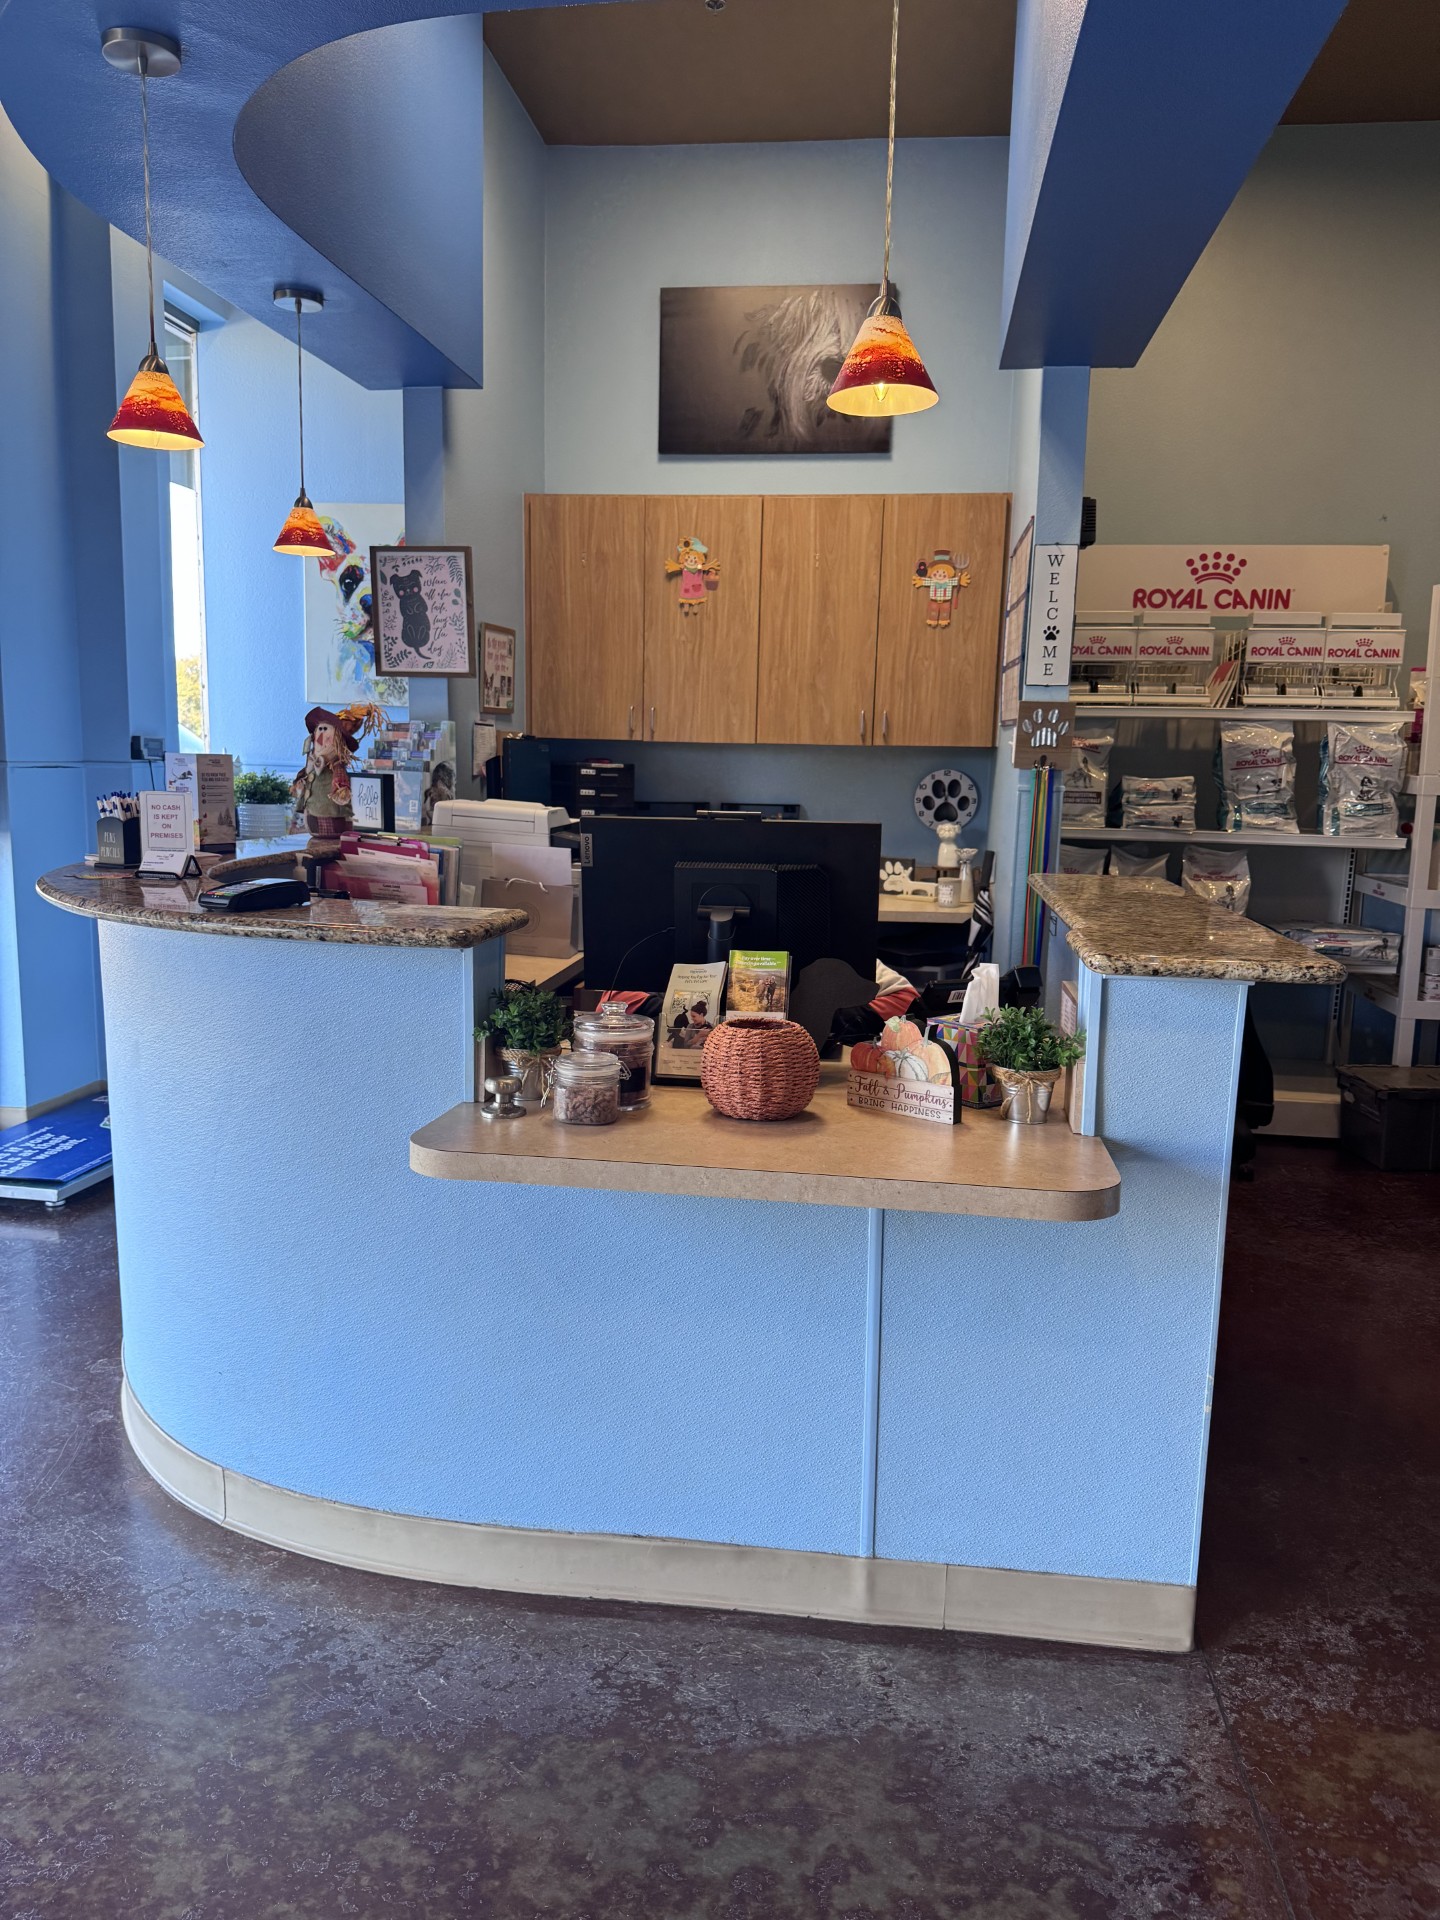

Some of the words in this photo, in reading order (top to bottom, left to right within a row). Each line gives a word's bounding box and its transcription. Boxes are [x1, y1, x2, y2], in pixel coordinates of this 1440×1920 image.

[425, 588, 436, 600] all
[1132, 588, 1208, 609] ROYAL
[1213, 588, 1291, 610] CANIN
[433, 615, 449, 628] hug
[1042, 553, 1065, 677] WELCME
[427, 641, 443, 656] dog
[1071, 646, 1095, 655] OYAL
[1097, 646, 1133, 656] CANIN
[1139, 646, 1172, 656] ROYAL
[1175, 646, 1210, 656] CANIN
[1250, 646, 1285, 657] ROYAL
[1287, 646, 1323, 657] CANIN
[1327, 648, 1362, 658] ROYAL
[1364, 648, 1400, 658] CANIN
[1235, 758, 1260, 767] ROYAL
[1362, 755, 1388, 764] ANIN
[358, 784, 379, 807] hello
[161, 813, 179, 821] KEPT
[365, 806, 379, 821] FALL
[104, 831, 116, 843] PENS
[100, 846, 121, 859] PENCILS
[855, 1075, 880, 1096] Fall
[883, 1087, 890, 1096] &
[894, 1083, 949, 1108] Pumpkins
[858, 1096, 885, 1109] BRING
[891, 1102, 942, 1119] HAPPINESS
[0, 1160, 37, 1177] deal
